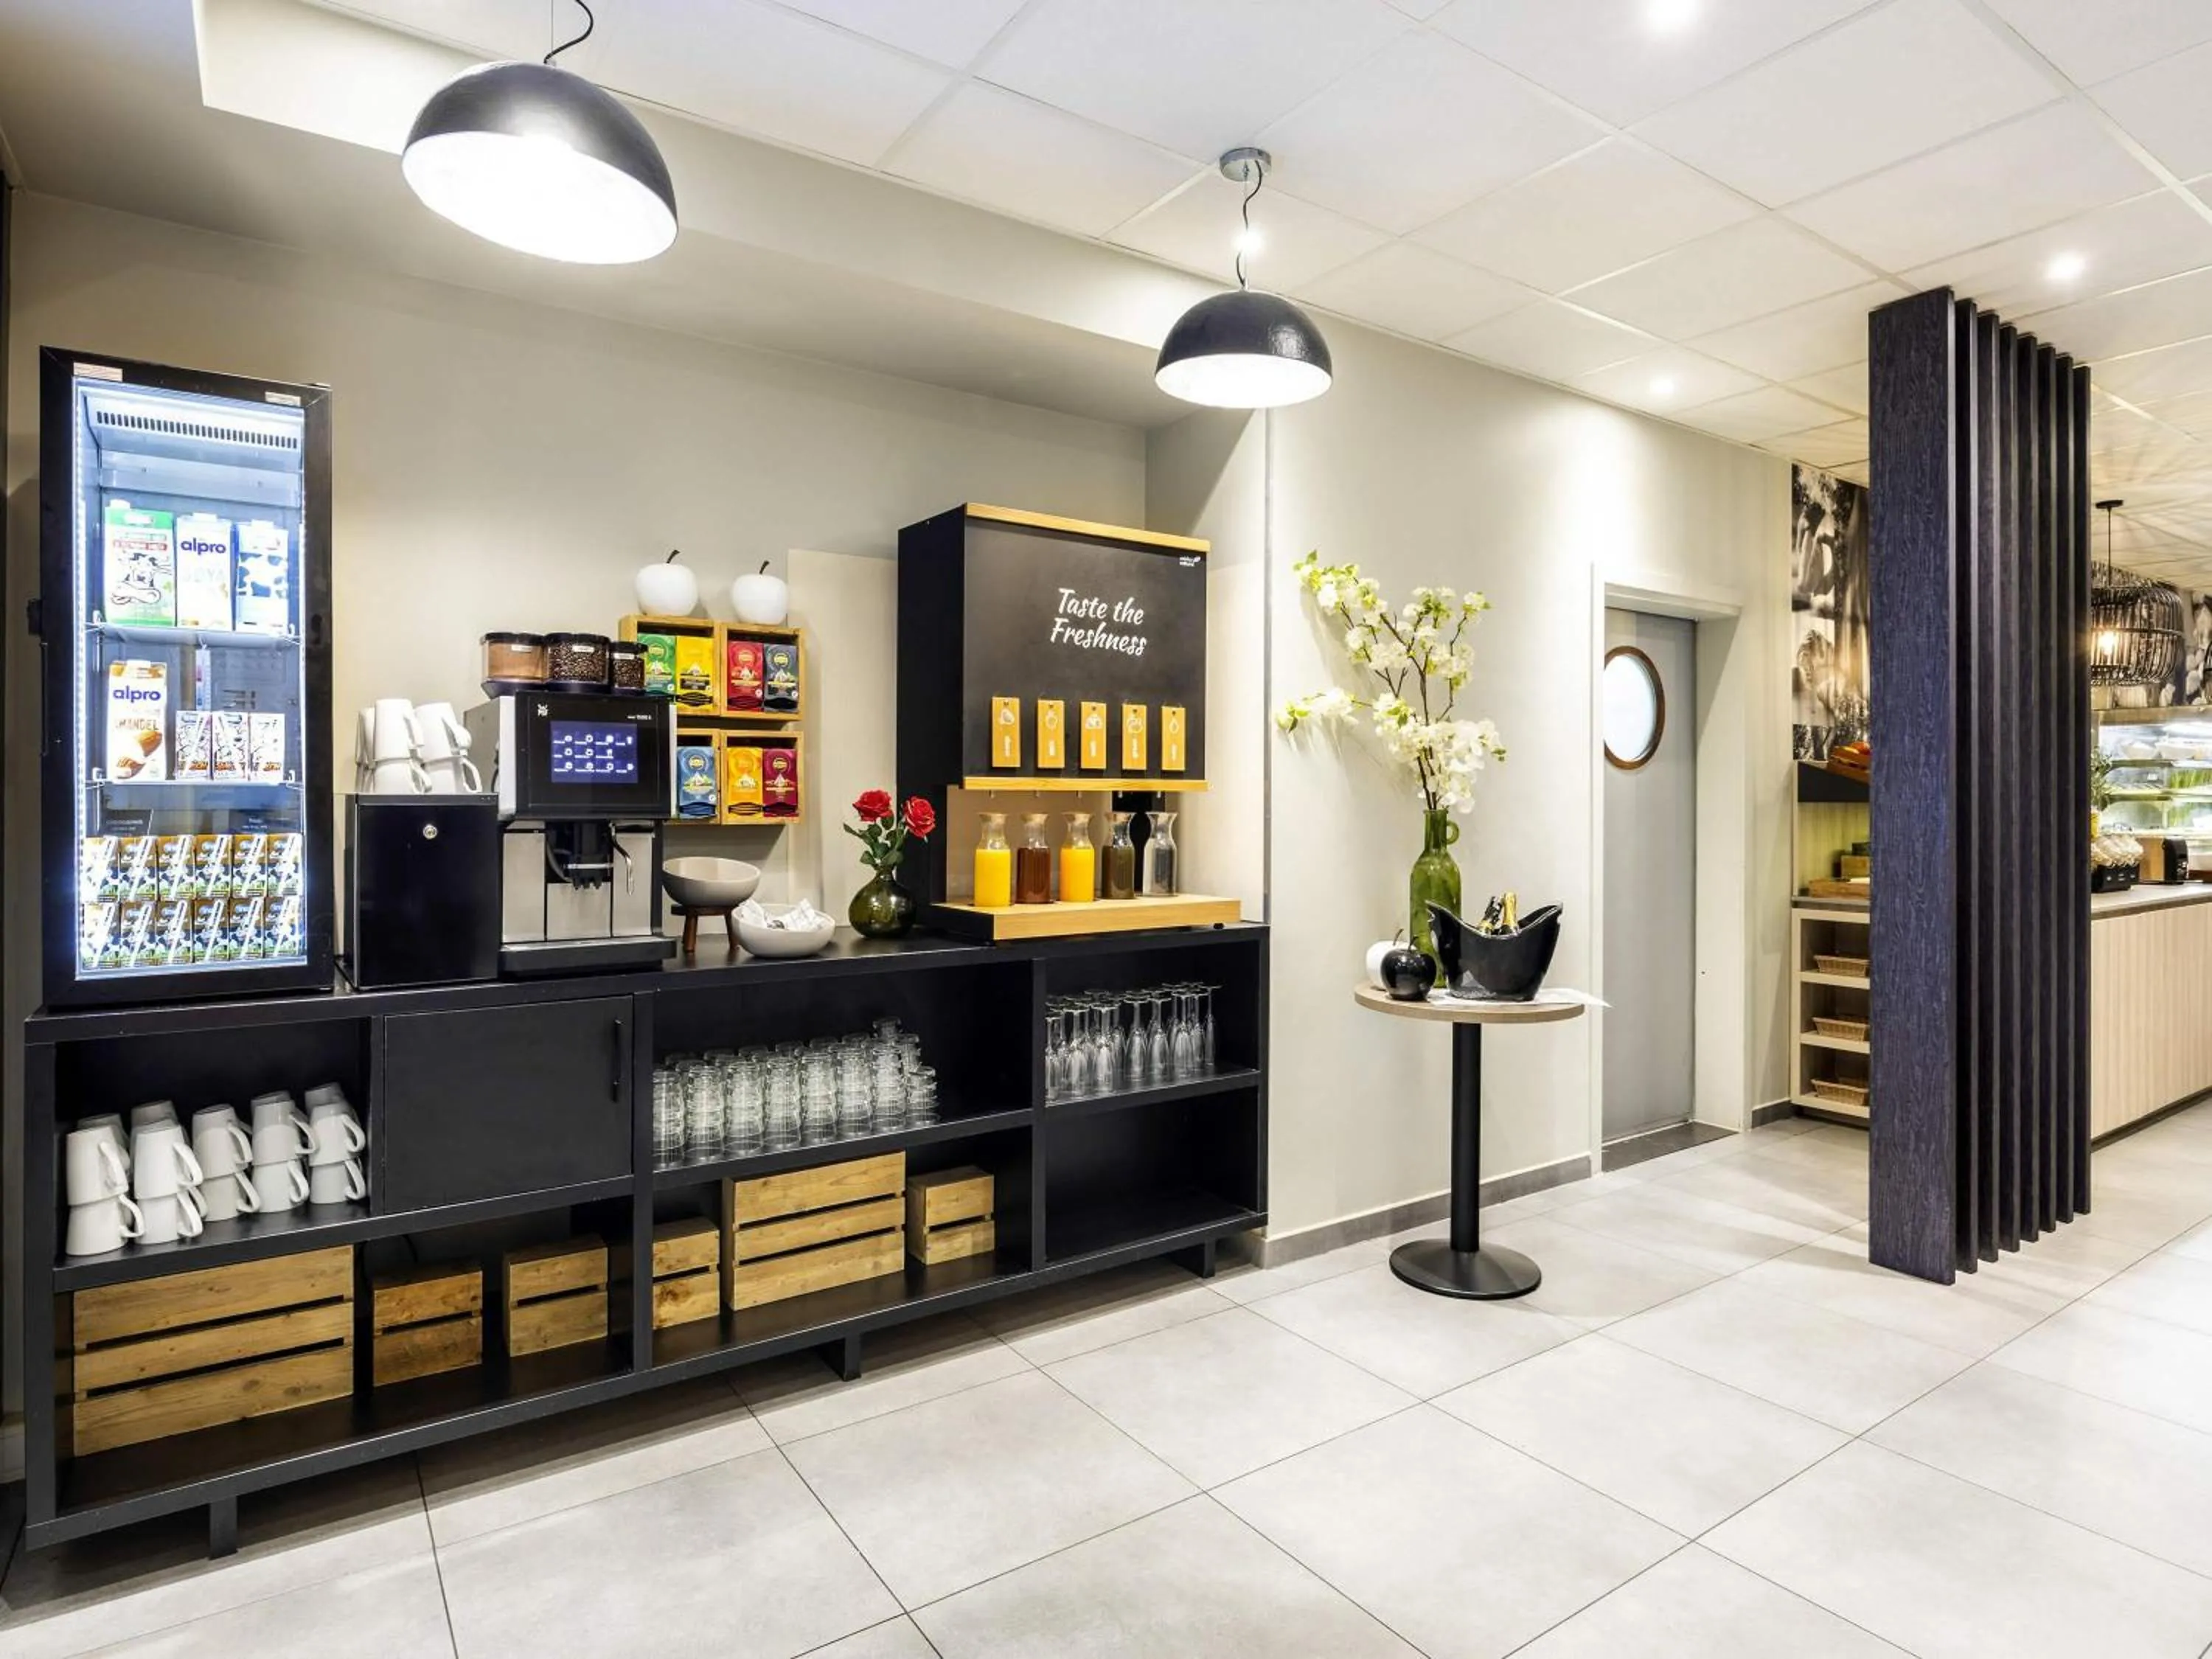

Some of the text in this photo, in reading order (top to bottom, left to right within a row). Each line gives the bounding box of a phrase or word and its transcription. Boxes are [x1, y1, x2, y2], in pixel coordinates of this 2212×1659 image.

[181, 538, 226, 555] alpro
[1058, 588, 1144, 625] Taste the
[1050, 617, 1147, 655] Freshness
[113, 686, 161, 703] alpro
